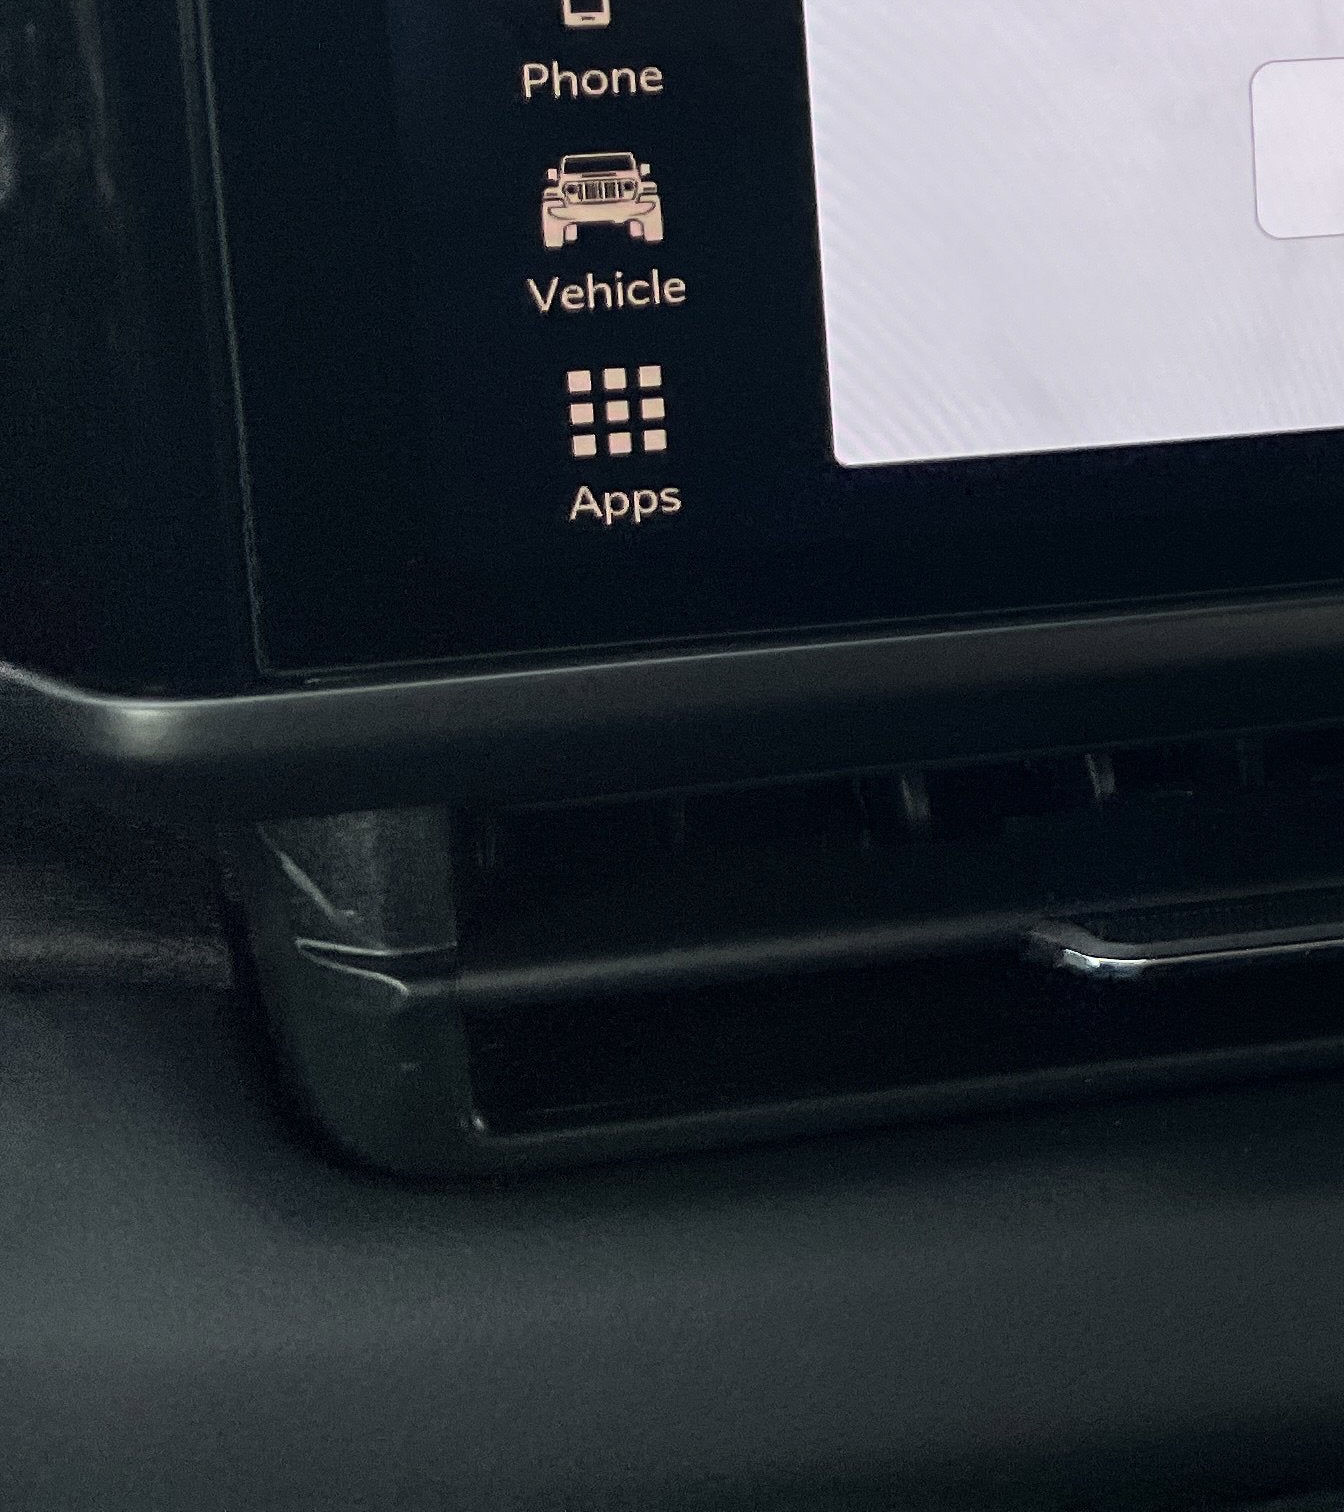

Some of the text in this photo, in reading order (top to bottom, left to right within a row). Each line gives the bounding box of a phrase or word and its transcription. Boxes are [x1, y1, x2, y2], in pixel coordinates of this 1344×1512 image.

[522, 60, 664, 100] Phone
[526, 268, 687, 312] Vehicle
[569, 485, 682, 525] Apps
